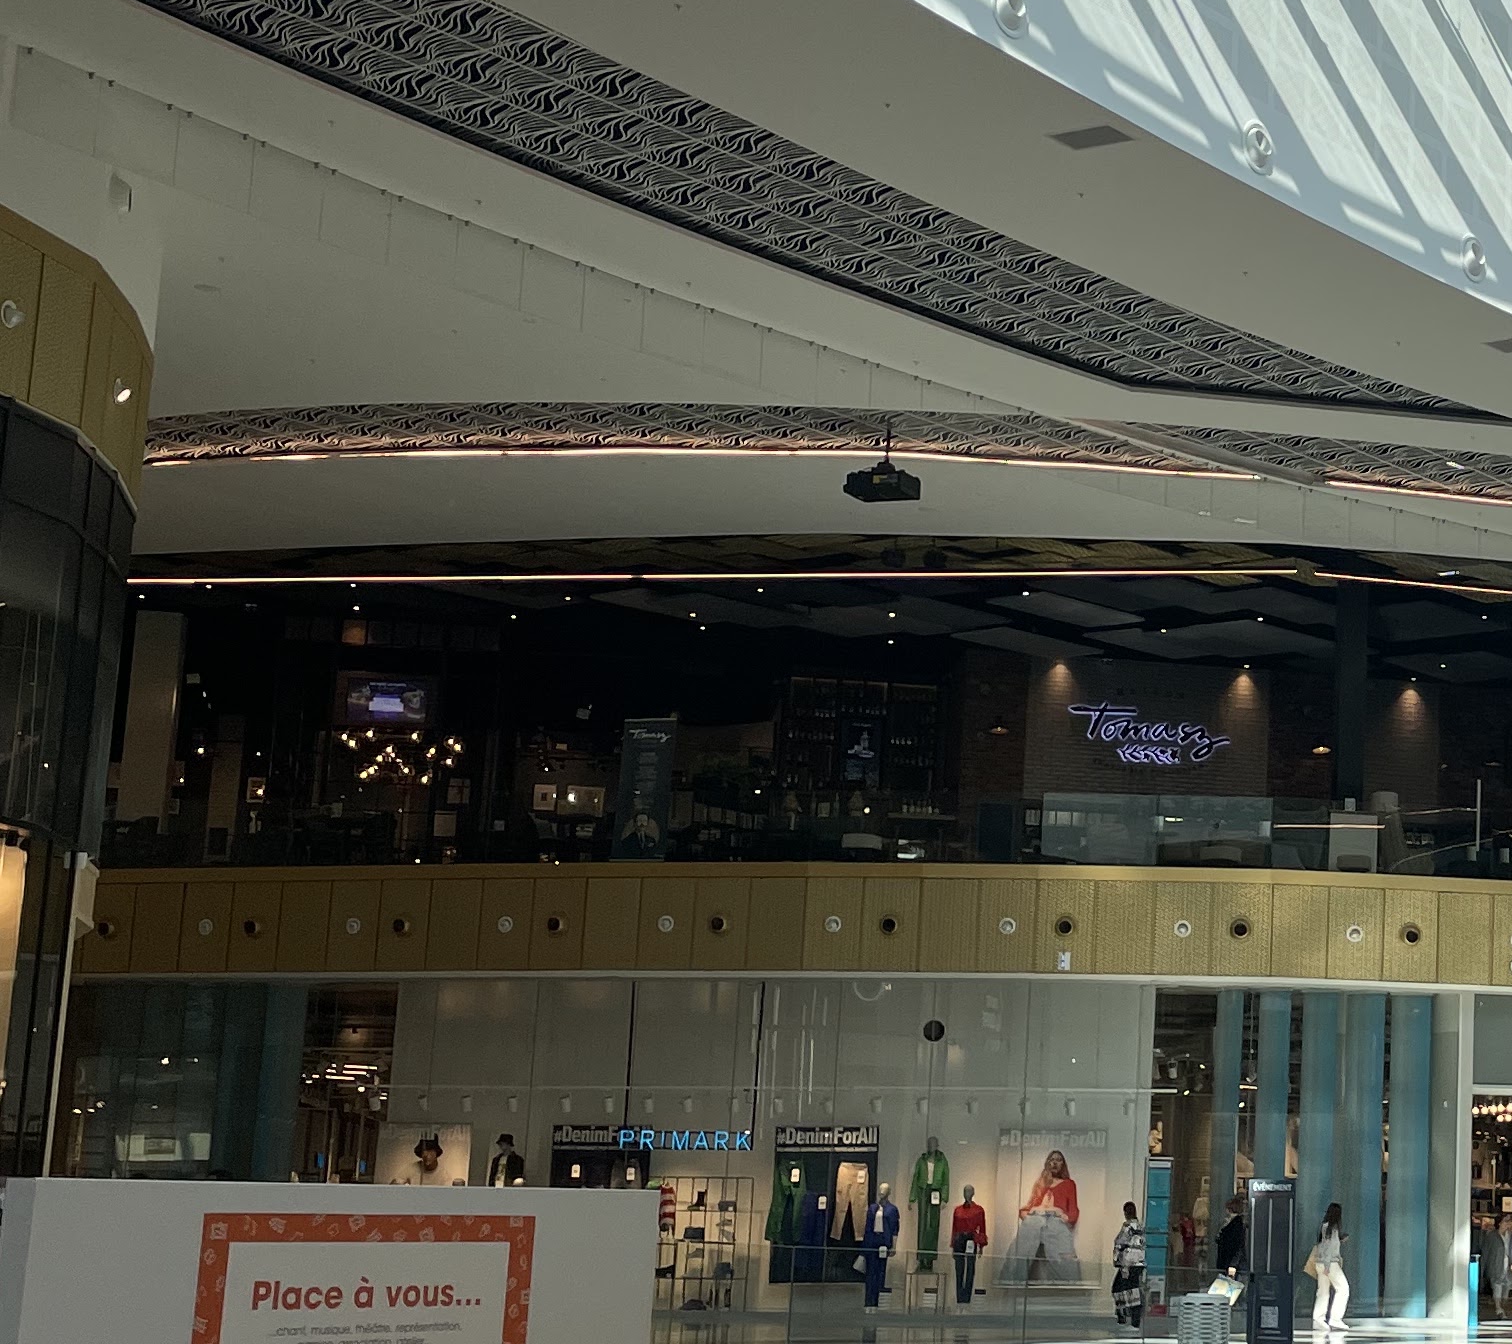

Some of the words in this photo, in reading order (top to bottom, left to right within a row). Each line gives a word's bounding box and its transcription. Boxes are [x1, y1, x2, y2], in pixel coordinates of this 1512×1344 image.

[1069, 702, 1231, 762] Tomasz
[618, 1129, 752, 1152] PRIMARK
[776, 1126, 878, 1145] #DenimForAll
[252, 1280, 344, 1311] Place
[353, 1275, 375, 1308] à
[386, 1282, 482, 1308] vous...
